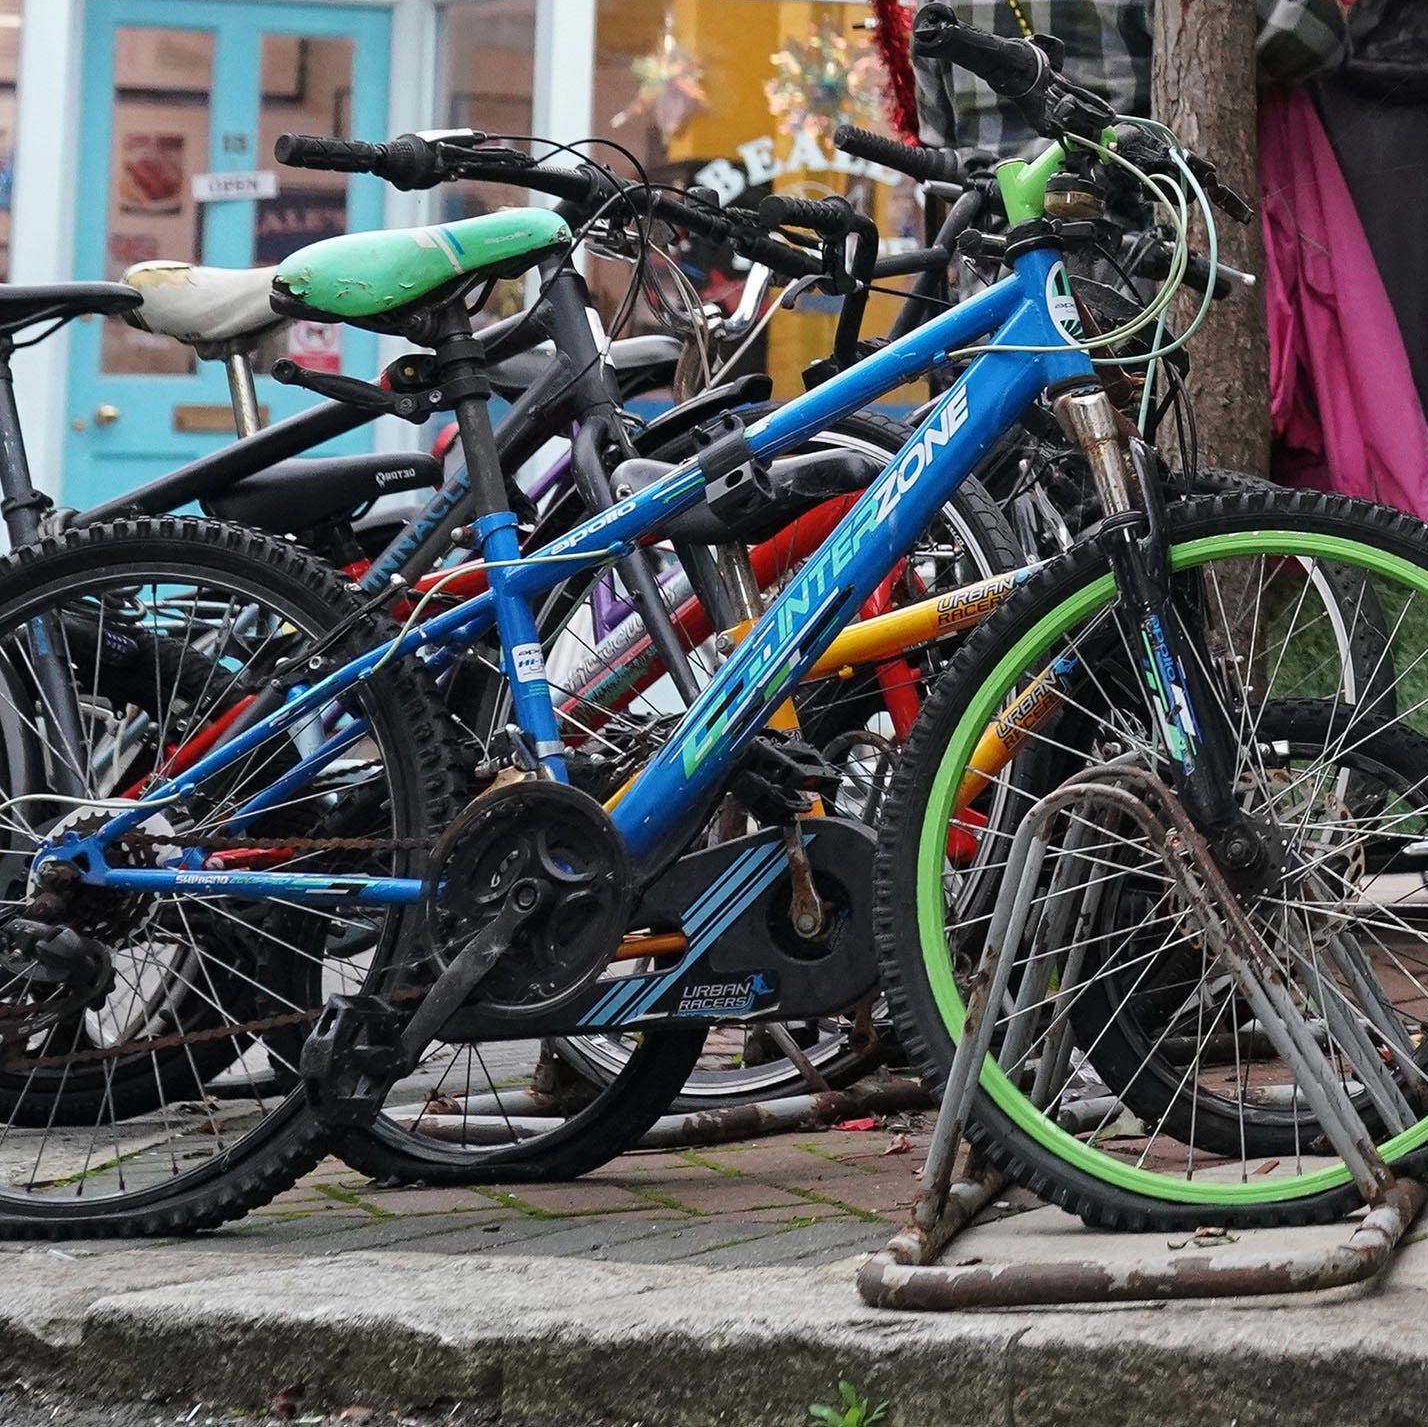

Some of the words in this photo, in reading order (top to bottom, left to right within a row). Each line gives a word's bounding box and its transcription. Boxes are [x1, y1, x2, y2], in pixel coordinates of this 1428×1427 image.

[551, 501, 637, 556] apollo
[937, 577, 1016, 613] URBAN
[679, 996, 748, 1011] RACERS
[682, 981, 752, 999] URBAN
